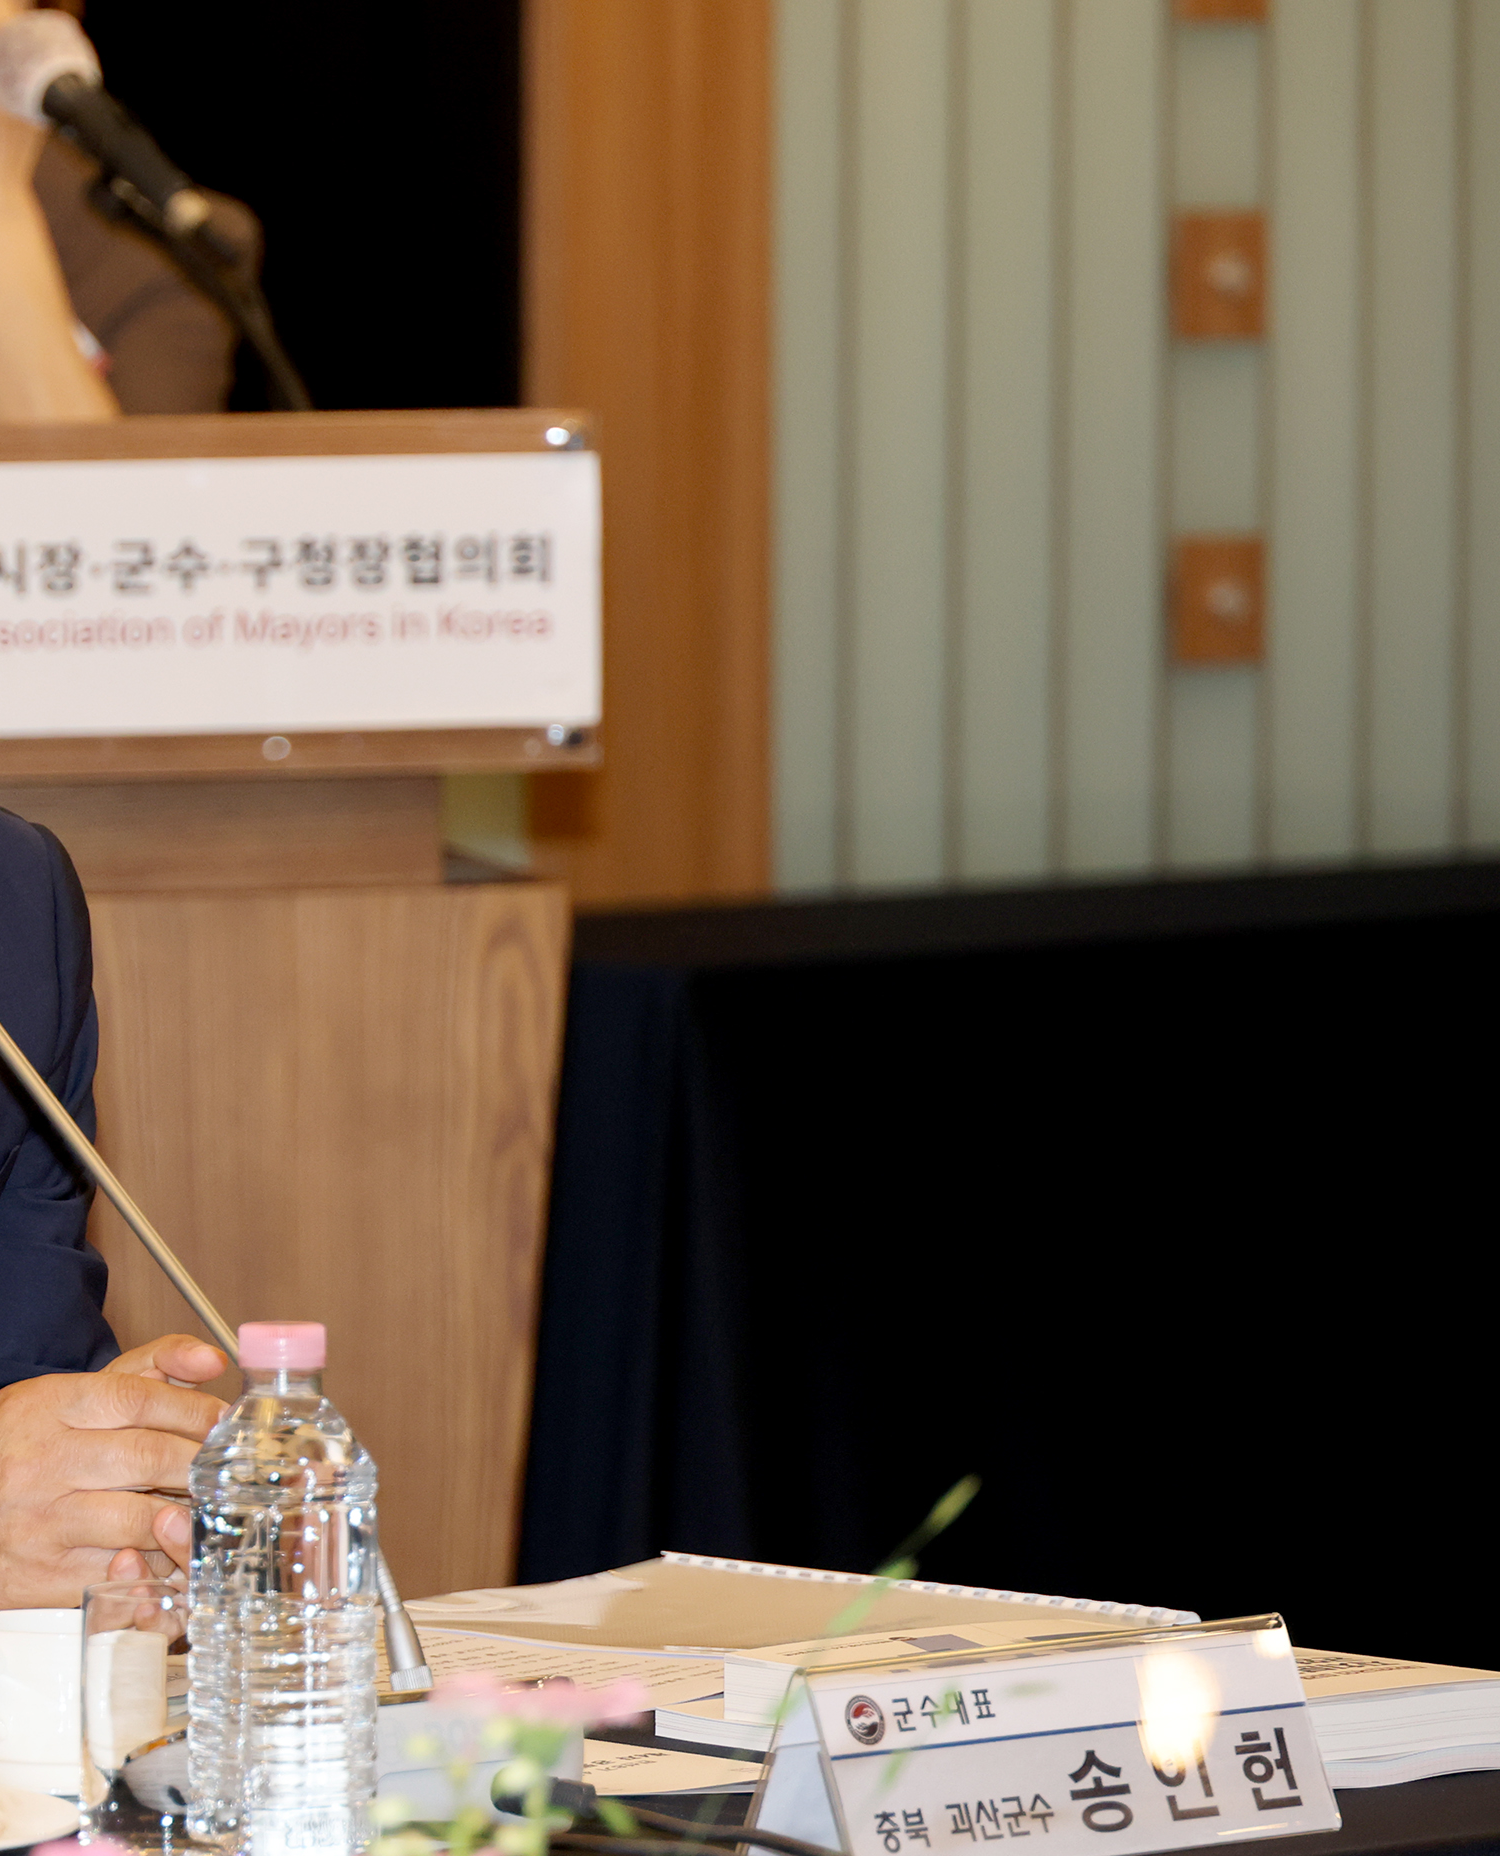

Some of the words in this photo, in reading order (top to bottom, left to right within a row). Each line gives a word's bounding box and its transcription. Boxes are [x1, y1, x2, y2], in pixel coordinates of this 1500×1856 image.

[181, 605, 224, 649] of
[234, 605, 384, 654] Mayors
[390, 601, 431, 642] in
[436, 602, 552, 642] Korea
[891, 1688, 996, 1733] 군수대표
[874, 1807, 932, 1854] 충북
[945, 1793, 1056, 1842] 괴산군수
